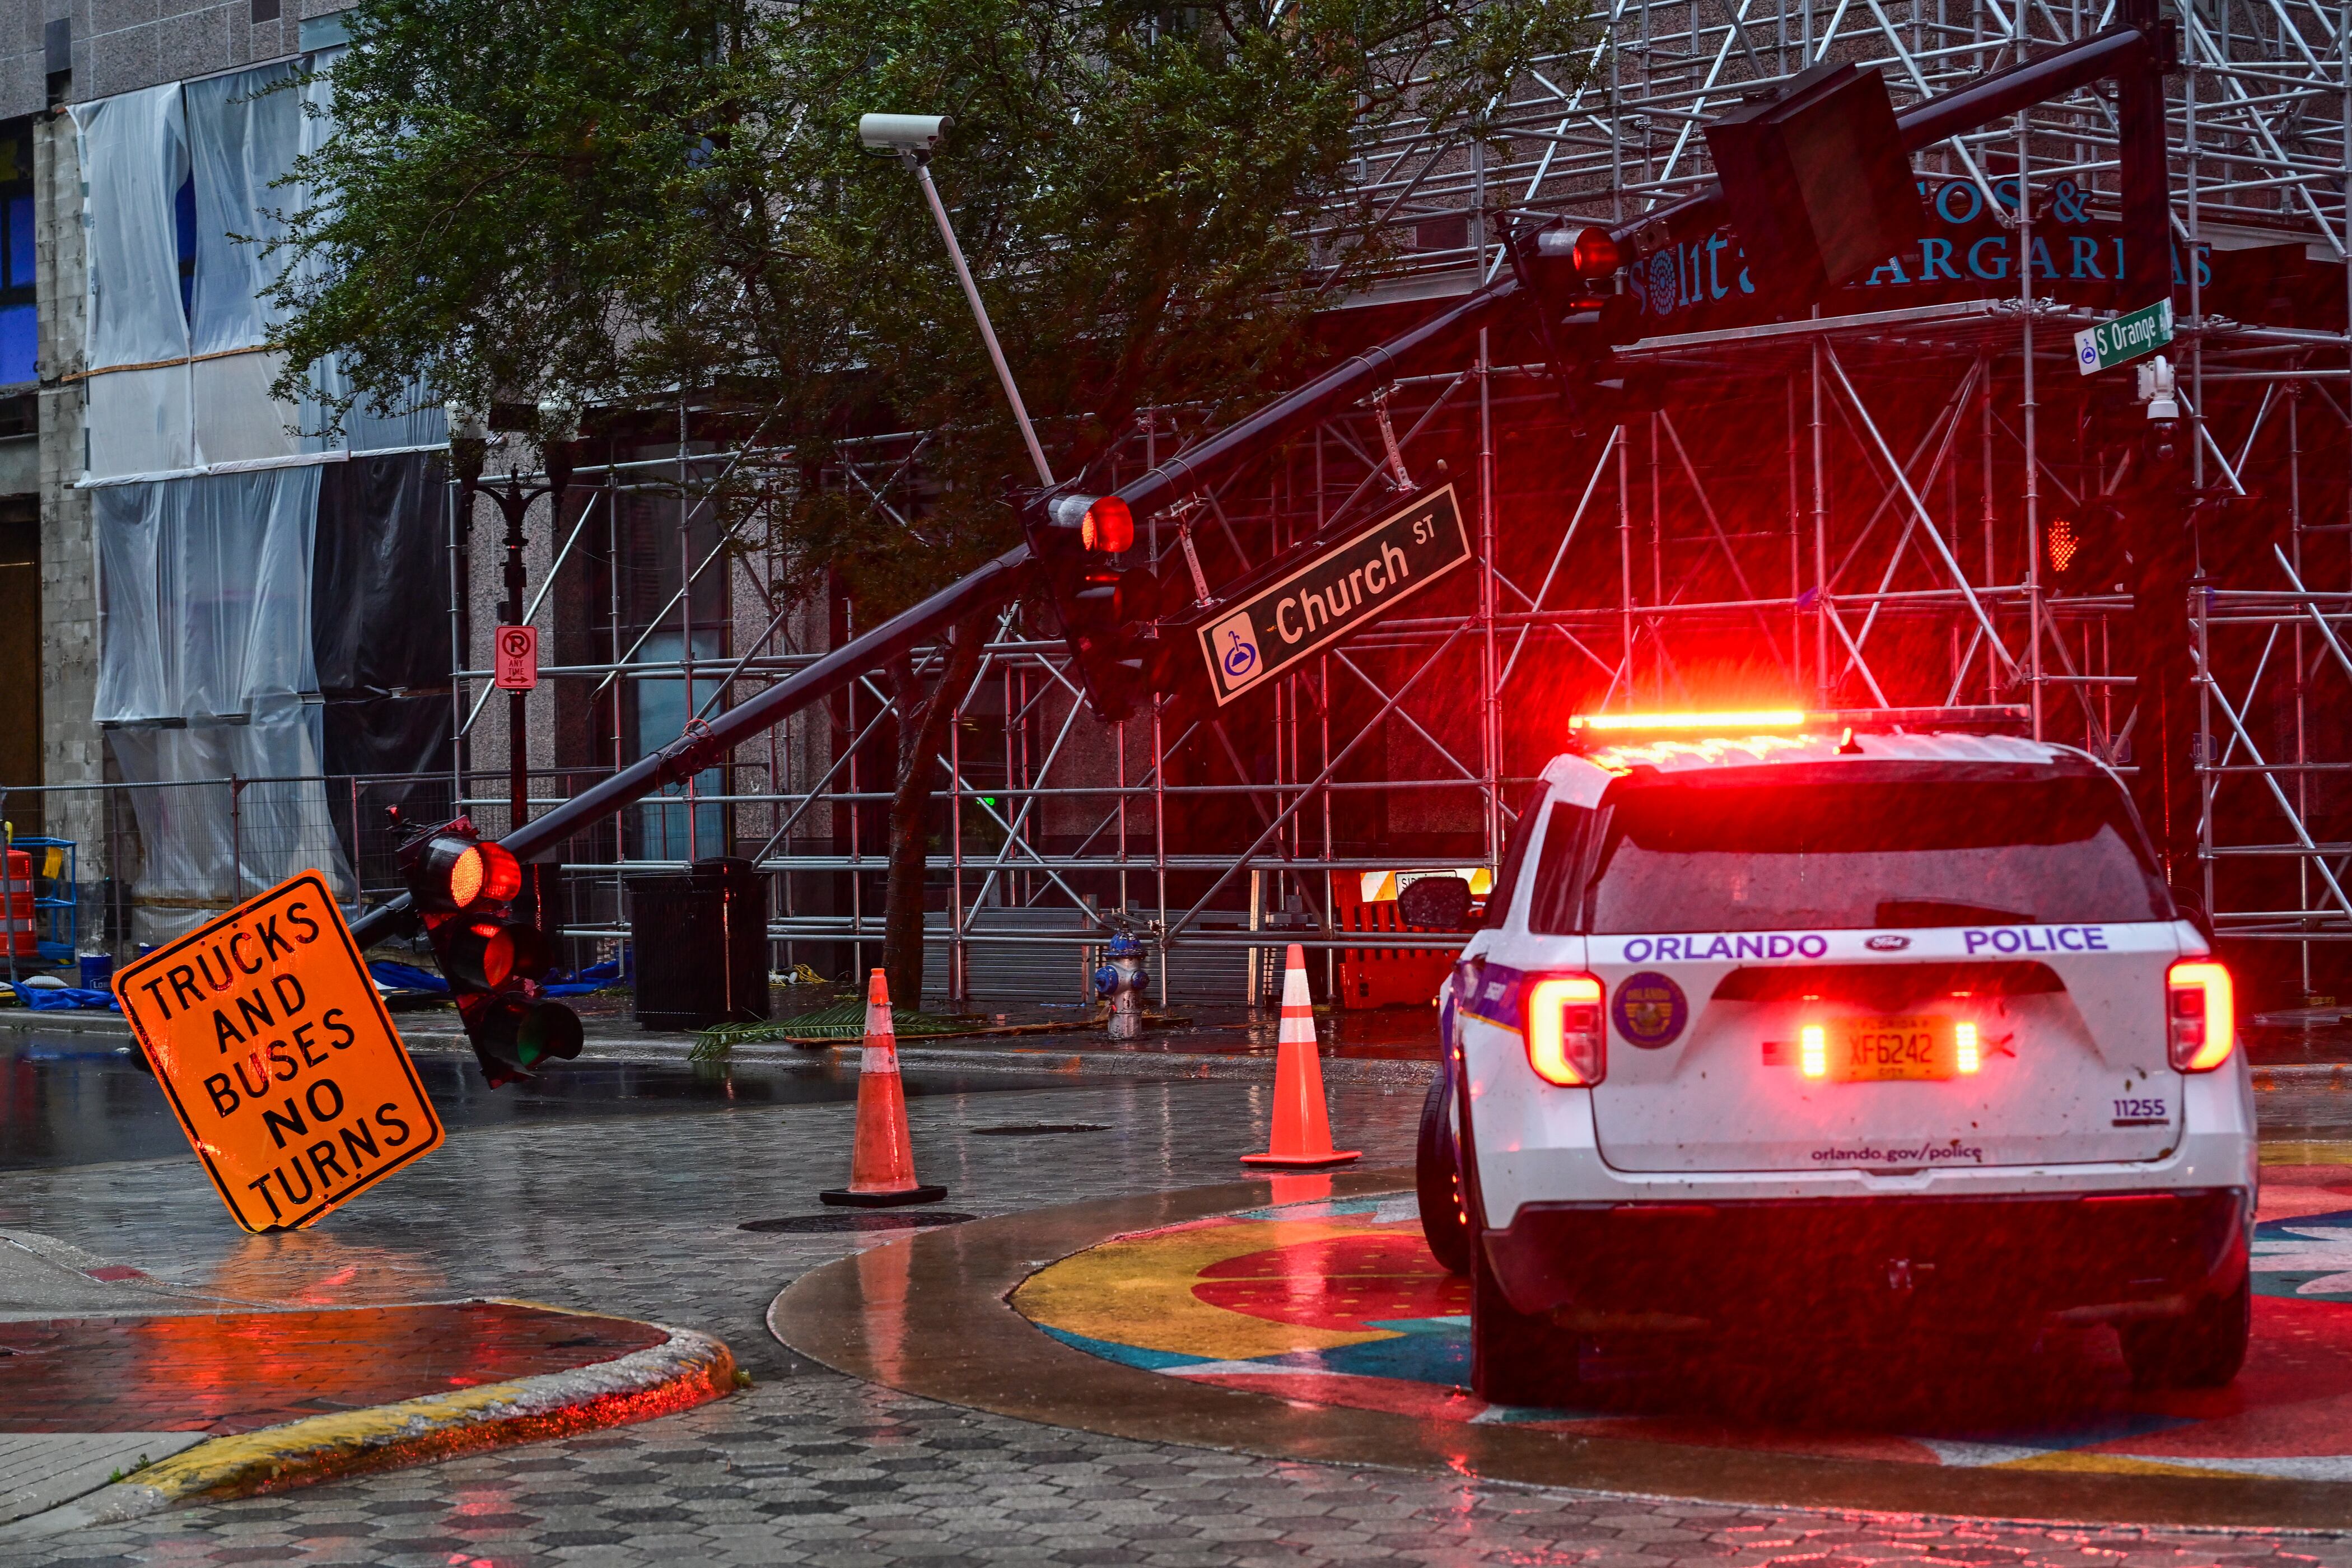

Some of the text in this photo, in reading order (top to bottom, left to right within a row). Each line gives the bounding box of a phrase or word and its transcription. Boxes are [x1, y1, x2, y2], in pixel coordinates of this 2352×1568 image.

[2054, 180, 2091, 223] &
[1850, 236, 2211, 287] ARGARIAS
[2096, 328, 2108, 356] S
[2112, 316, 2156, 350] Orange
[1276, 514, 1435, 644] Church ST
[141, 902, 320, 1020] TRUCKS
[1624, 927, 2108, 963] ORLANDO POLICE
[212, 973, 306, 1053] AND
[204, 1009, 355, 1118] BUSES
[1849, 1032, 1933, 1064] XF6242
[261, 1079, 344, 1149] NO
[2113, 1099, 2166, 1116] 11255
[248, 1103, 410, 1220] TURNS
[1812, 1142, 1982, 1162] orlando.gov/police
